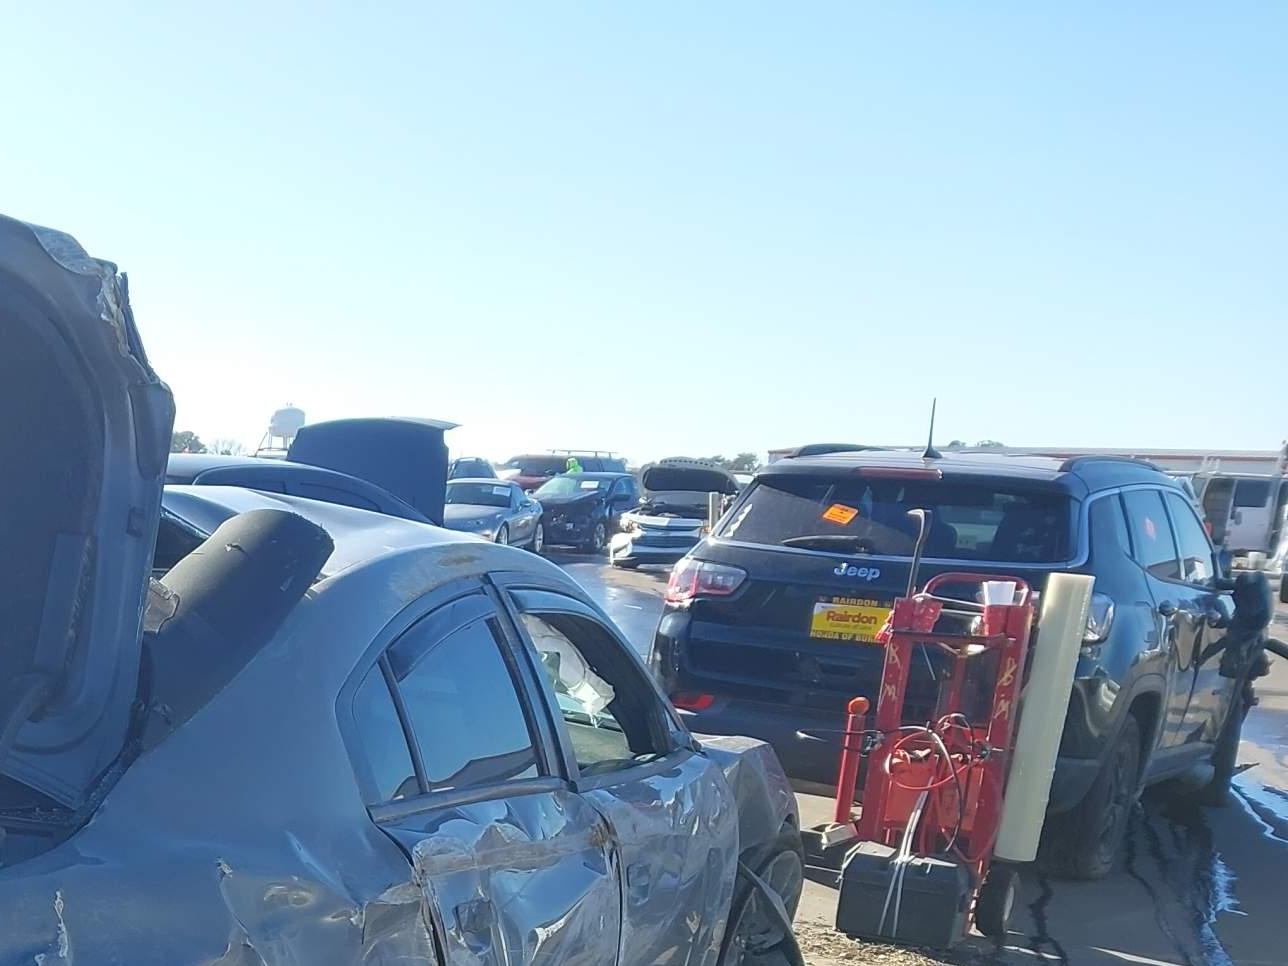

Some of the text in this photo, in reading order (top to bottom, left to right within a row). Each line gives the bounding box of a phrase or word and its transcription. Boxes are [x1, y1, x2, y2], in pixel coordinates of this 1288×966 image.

[834, 562, 880, 580] Jeep
[832, 597, 878, 607] RAIRDON
[826, 610, 877, 625] Rairdon
